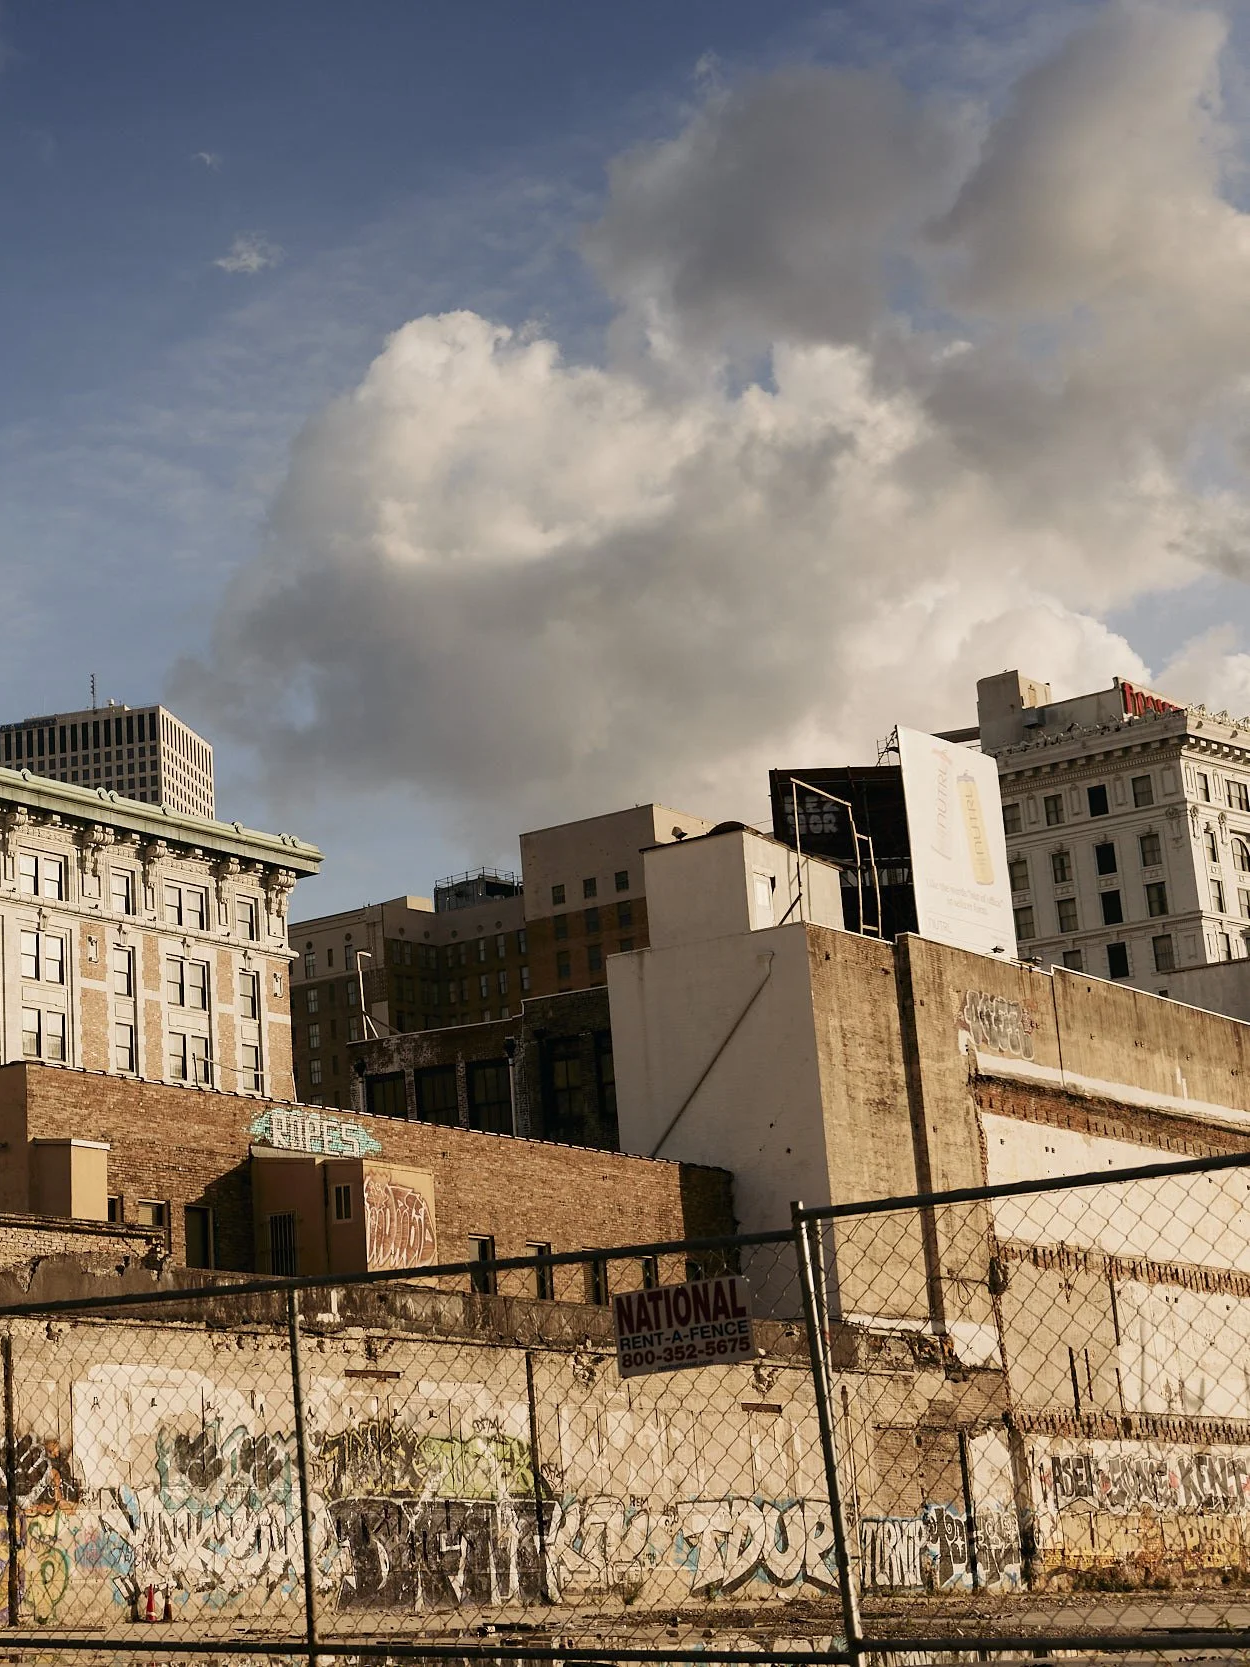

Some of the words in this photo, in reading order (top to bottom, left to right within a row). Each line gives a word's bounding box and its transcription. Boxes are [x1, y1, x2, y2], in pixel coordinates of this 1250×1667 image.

[270, 1111, 360, 1158] ROPES
[616, 1279, 747, 1336] NATIONAL
[619, 1319, 749, 1351] RENT-A-FENCE
[621, 1335, 751, 1368] 800-352-5675
